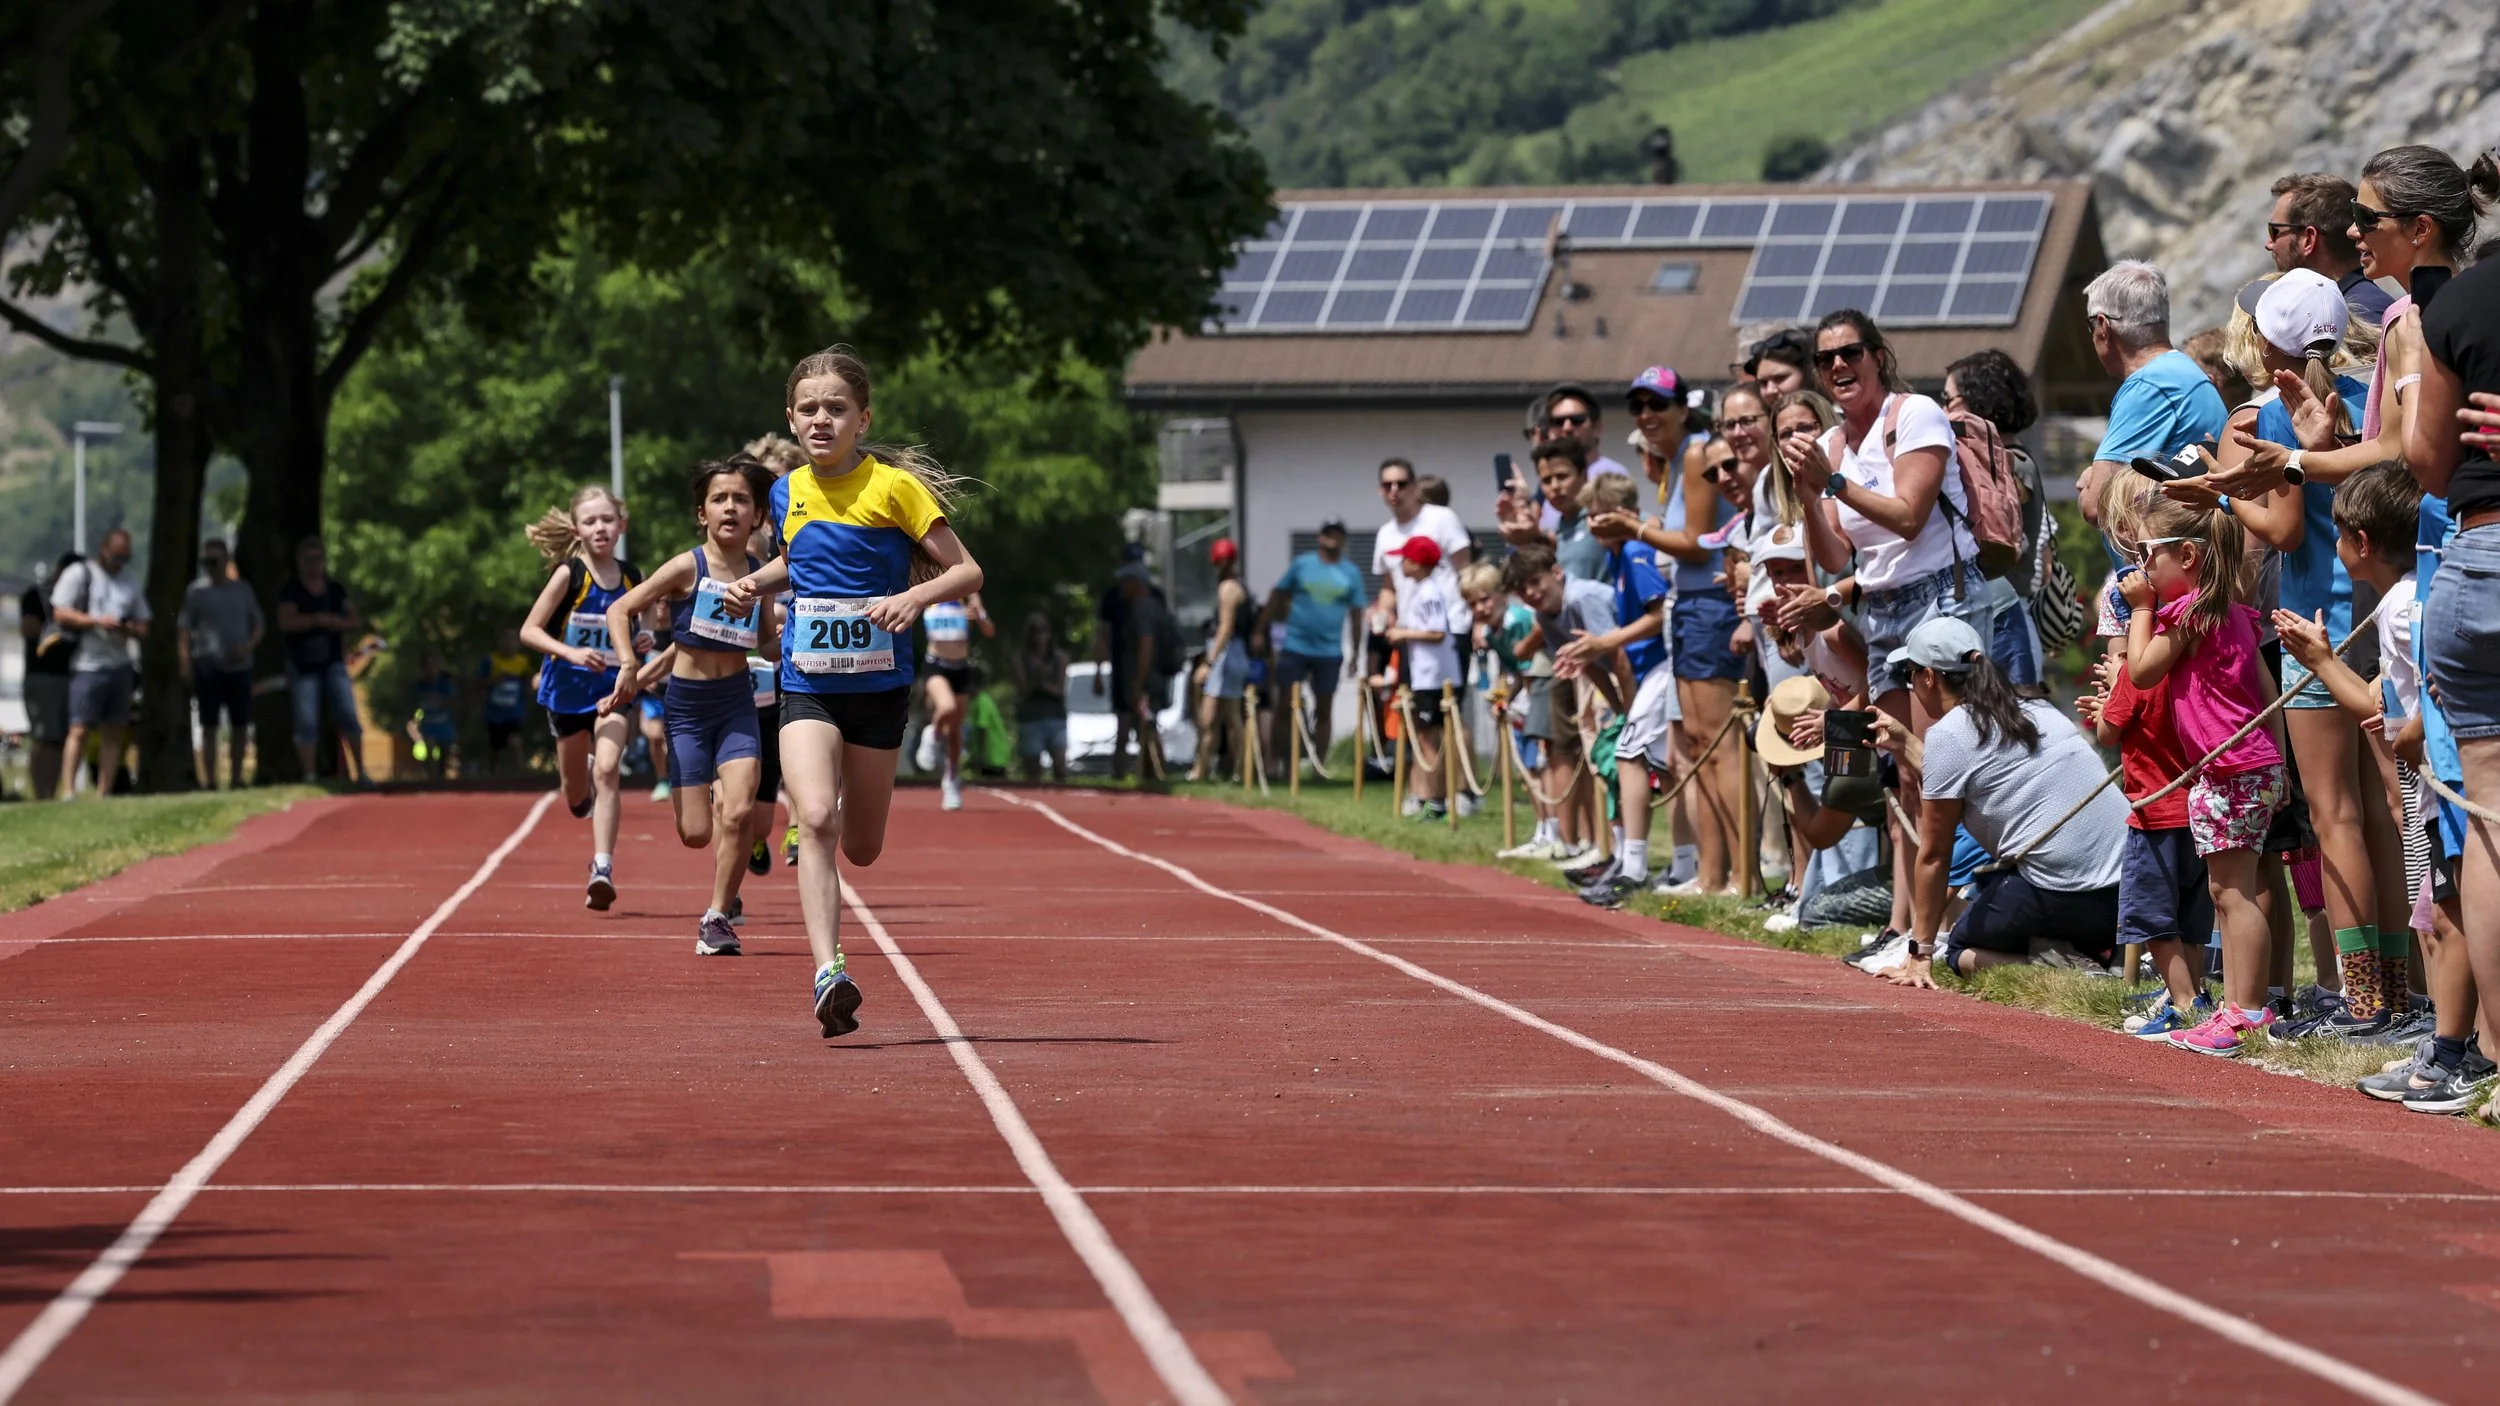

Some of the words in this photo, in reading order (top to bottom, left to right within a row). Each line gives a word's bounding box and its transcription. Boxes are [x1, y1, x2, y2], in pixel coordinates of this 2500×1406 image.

[2323, 325, 2337, 333] UBS
[812, 603, 836, 612] gampel
[810, 619, 871, 649] 209
[856, 657, 892, 667] RAIFFEISEN
